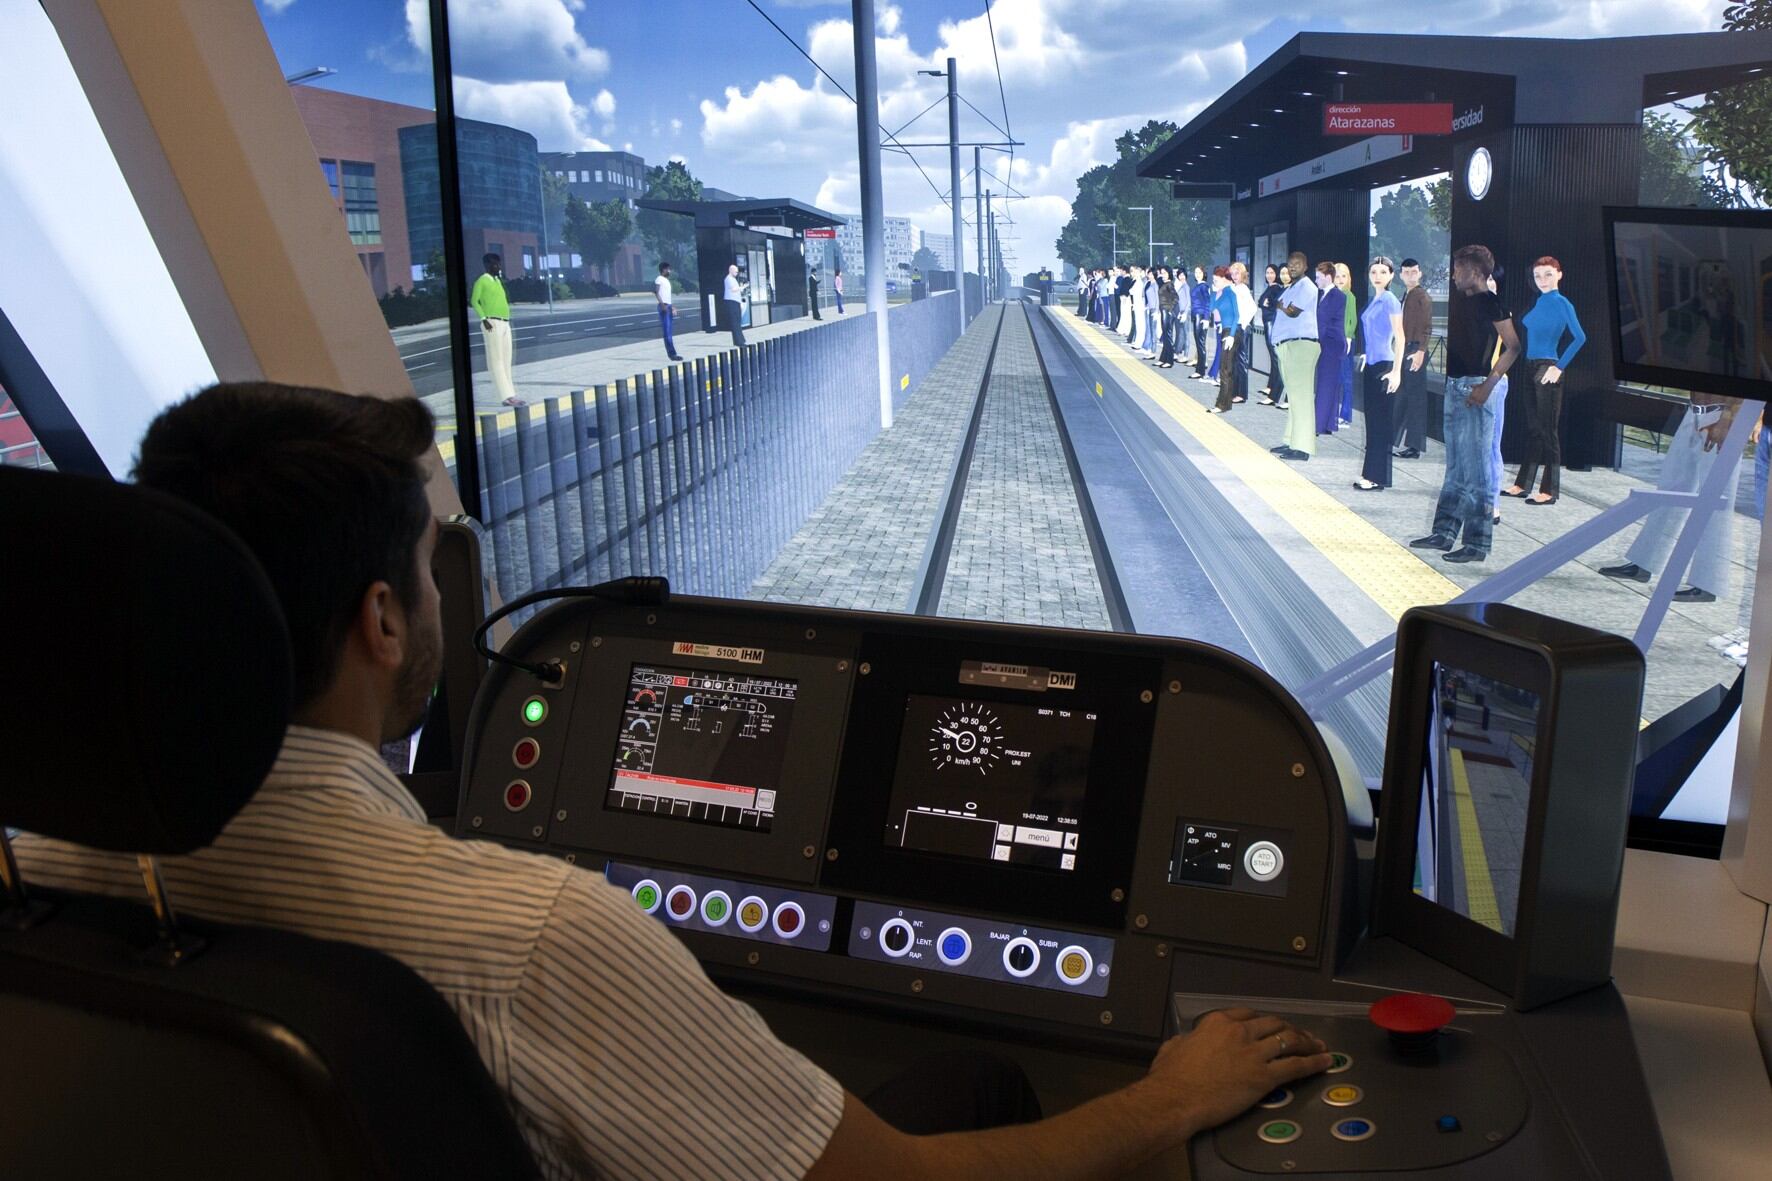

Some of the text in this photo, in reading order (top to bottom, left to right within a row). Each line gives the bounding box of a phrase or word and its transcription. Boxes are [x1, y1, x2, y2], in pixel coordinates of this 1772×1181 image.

[1329, 105, 1361, 113] dirección
[1452, 104, 1484, 131] ersidad
[1329, 116, 1395, 129] Atarazanas
[716, 647, 738, 658] 5100
[740, 649, 762, 661] IHM
[1050, 673, 1075, 687] DMI
[955, 757, 970, 765] km/h
[1254, 860, 1274, 868] START
[912, 920, 924, 928] INT.
[990, 932, 1010, 941] BAJAR
[916, 938, 933, 946] LENT.
[1038, 939, 1058, 949] SUBIR
[909, 952, 923, 960] RAP.
